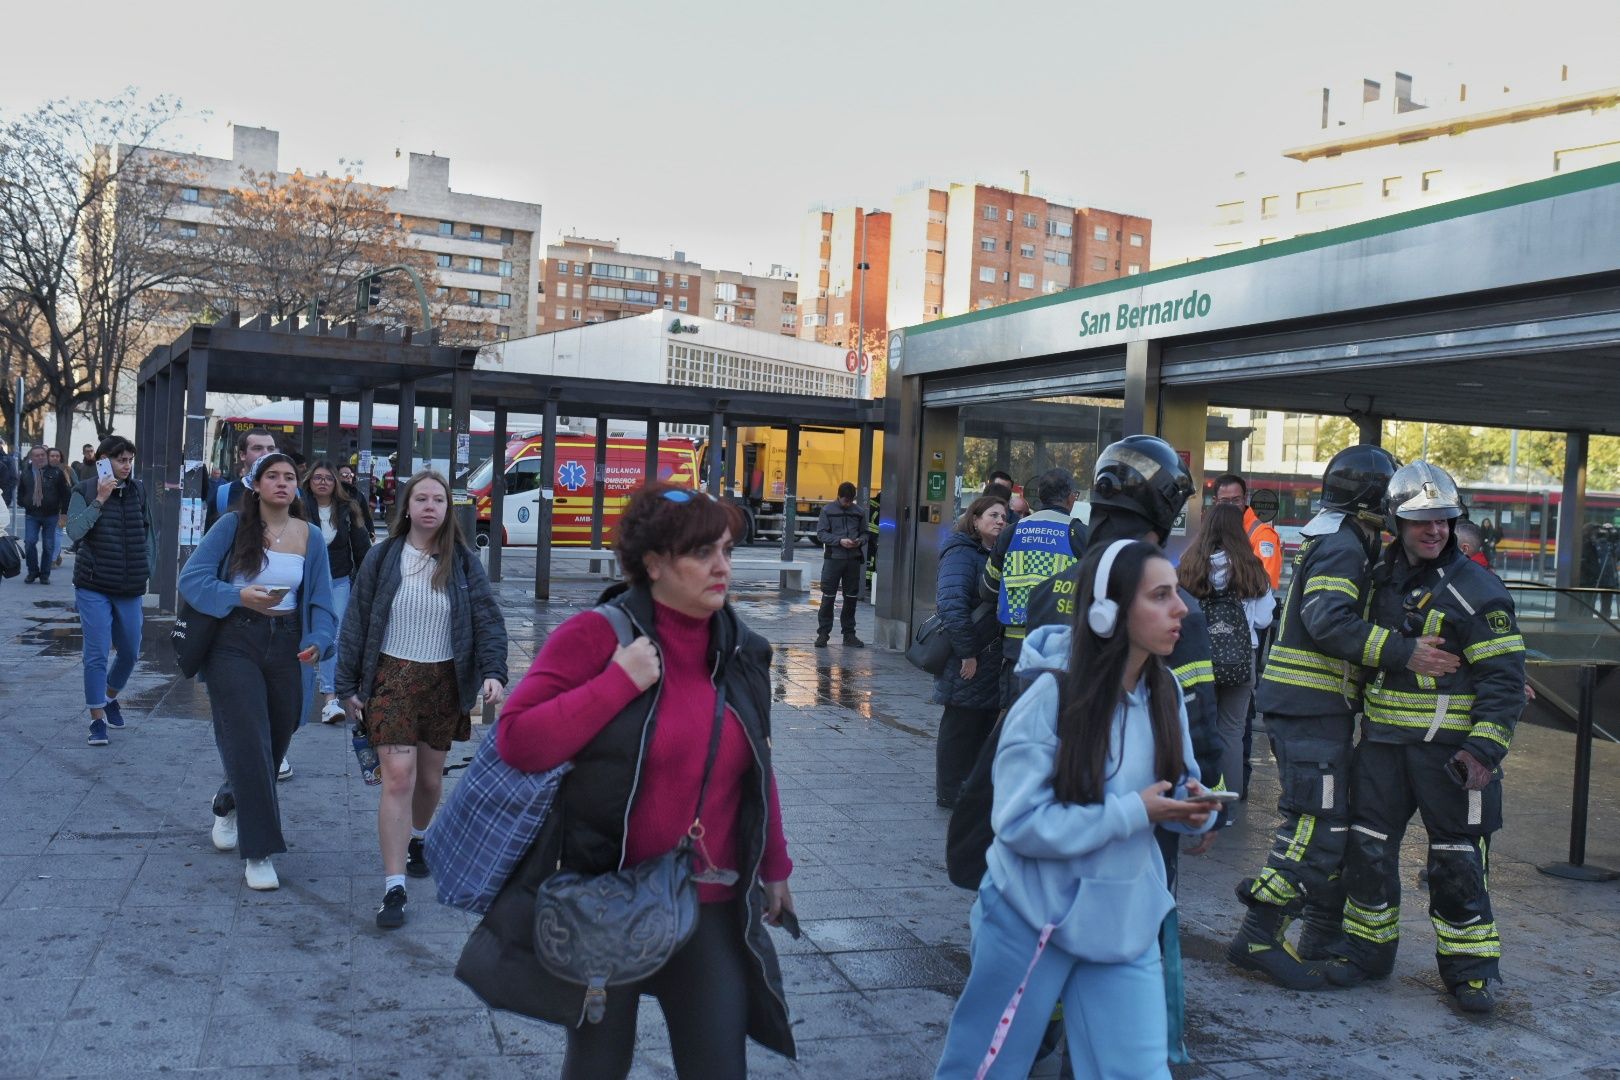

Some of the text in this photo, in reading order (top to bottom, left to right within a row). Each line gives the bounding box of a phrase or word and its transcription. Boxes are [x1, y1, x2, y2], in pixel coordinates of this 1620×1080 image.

[1079, 289, 1212, 337] San Bernardo
[604, 477, 637, 485] OMBEROS
[1015, 527, 1066, 537] BOMBEROS
[1021, 536, 1057, 546] SEVILLA
